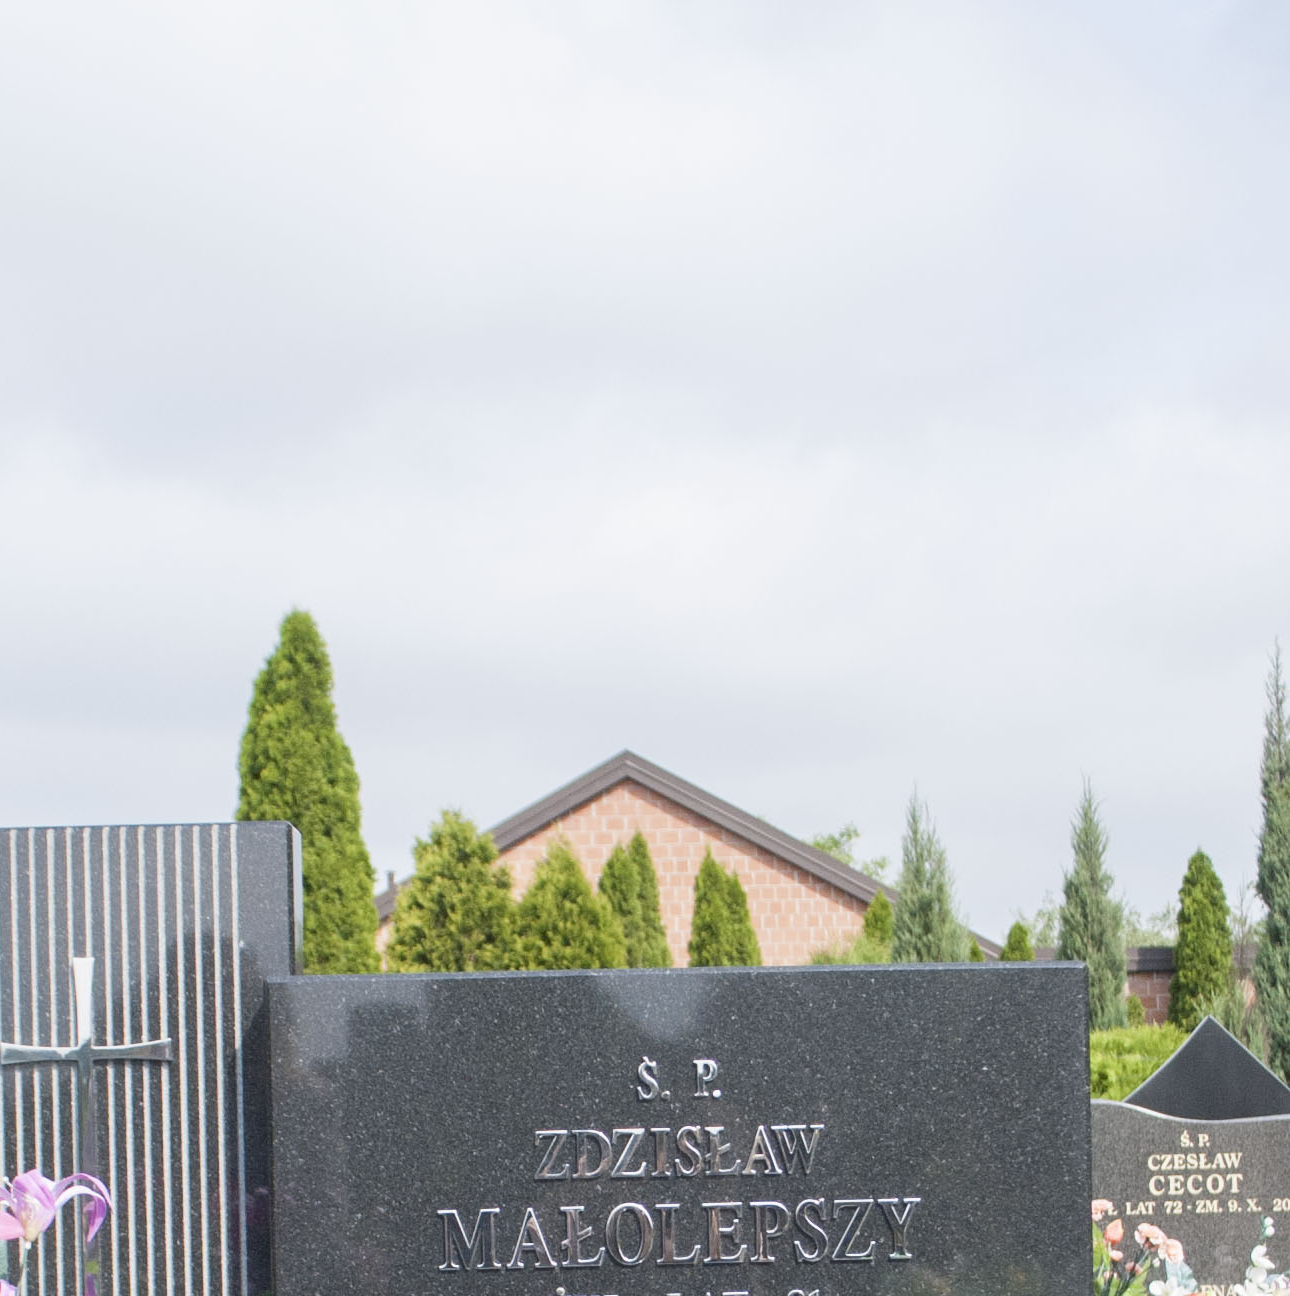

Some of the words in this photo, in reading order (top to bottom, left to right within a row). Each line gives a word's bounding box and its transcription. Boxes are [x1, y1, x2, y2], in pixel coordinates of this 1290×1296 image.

[534, 1124, 825, 1180] ZDZISŁAW
[1147, 1152, 1243, 1171] CZESŁAW
[1149, 1173, 1244, 1195] CECOT
[1125, 1201, 1156, 1215] LAT
[1164, 1200, 1183, 1214] 72
[1196, 1200, 1223, 1214] ZM.
[437, 1197, 922, 1271] MAŁOLEPSZY
